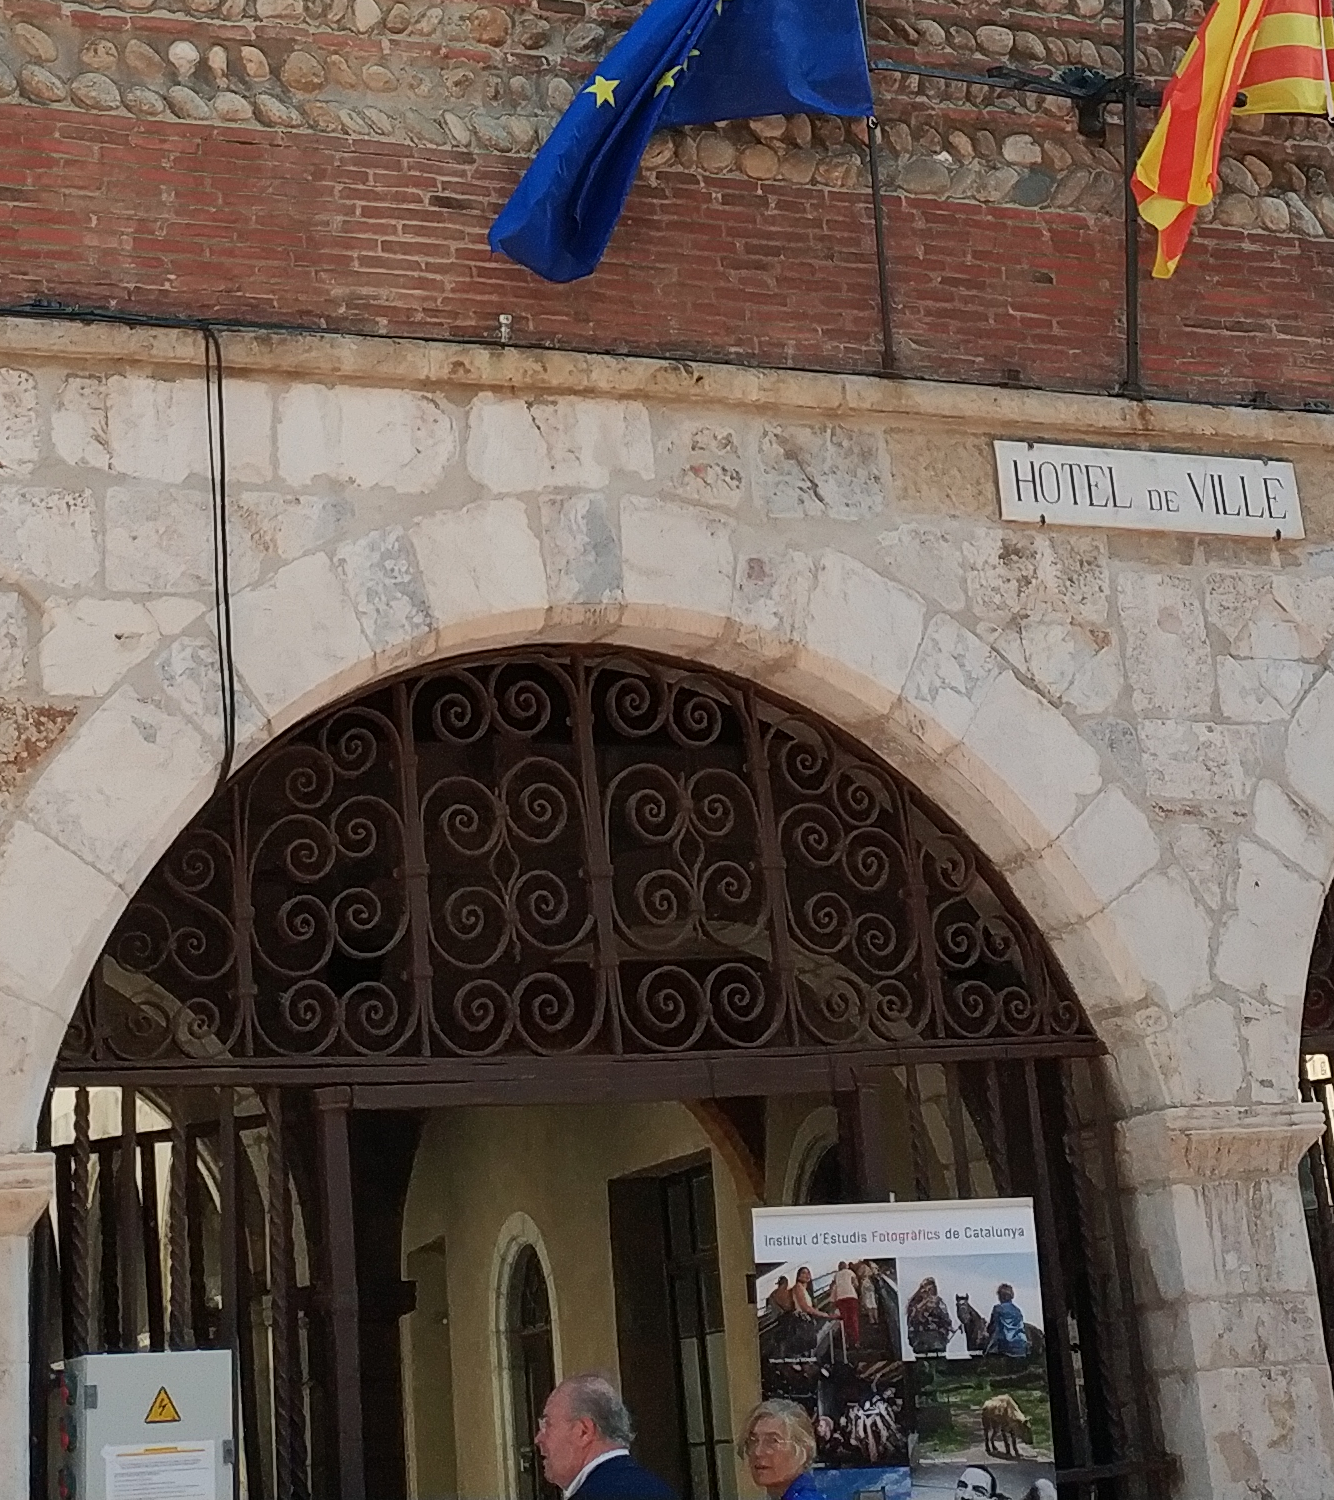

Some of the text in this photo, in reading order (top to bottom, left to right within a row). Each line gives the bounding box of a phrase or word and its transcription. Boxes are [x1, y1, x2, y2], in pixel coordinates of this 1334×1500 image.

[1012, 459, 1288, 520] HOTEL DE VILLE
[811, 1231, 867, 1246] d'Estudis
[945, 1228, 960, 1240] de
[964, 1226, 1025, 1239] Catalunya
